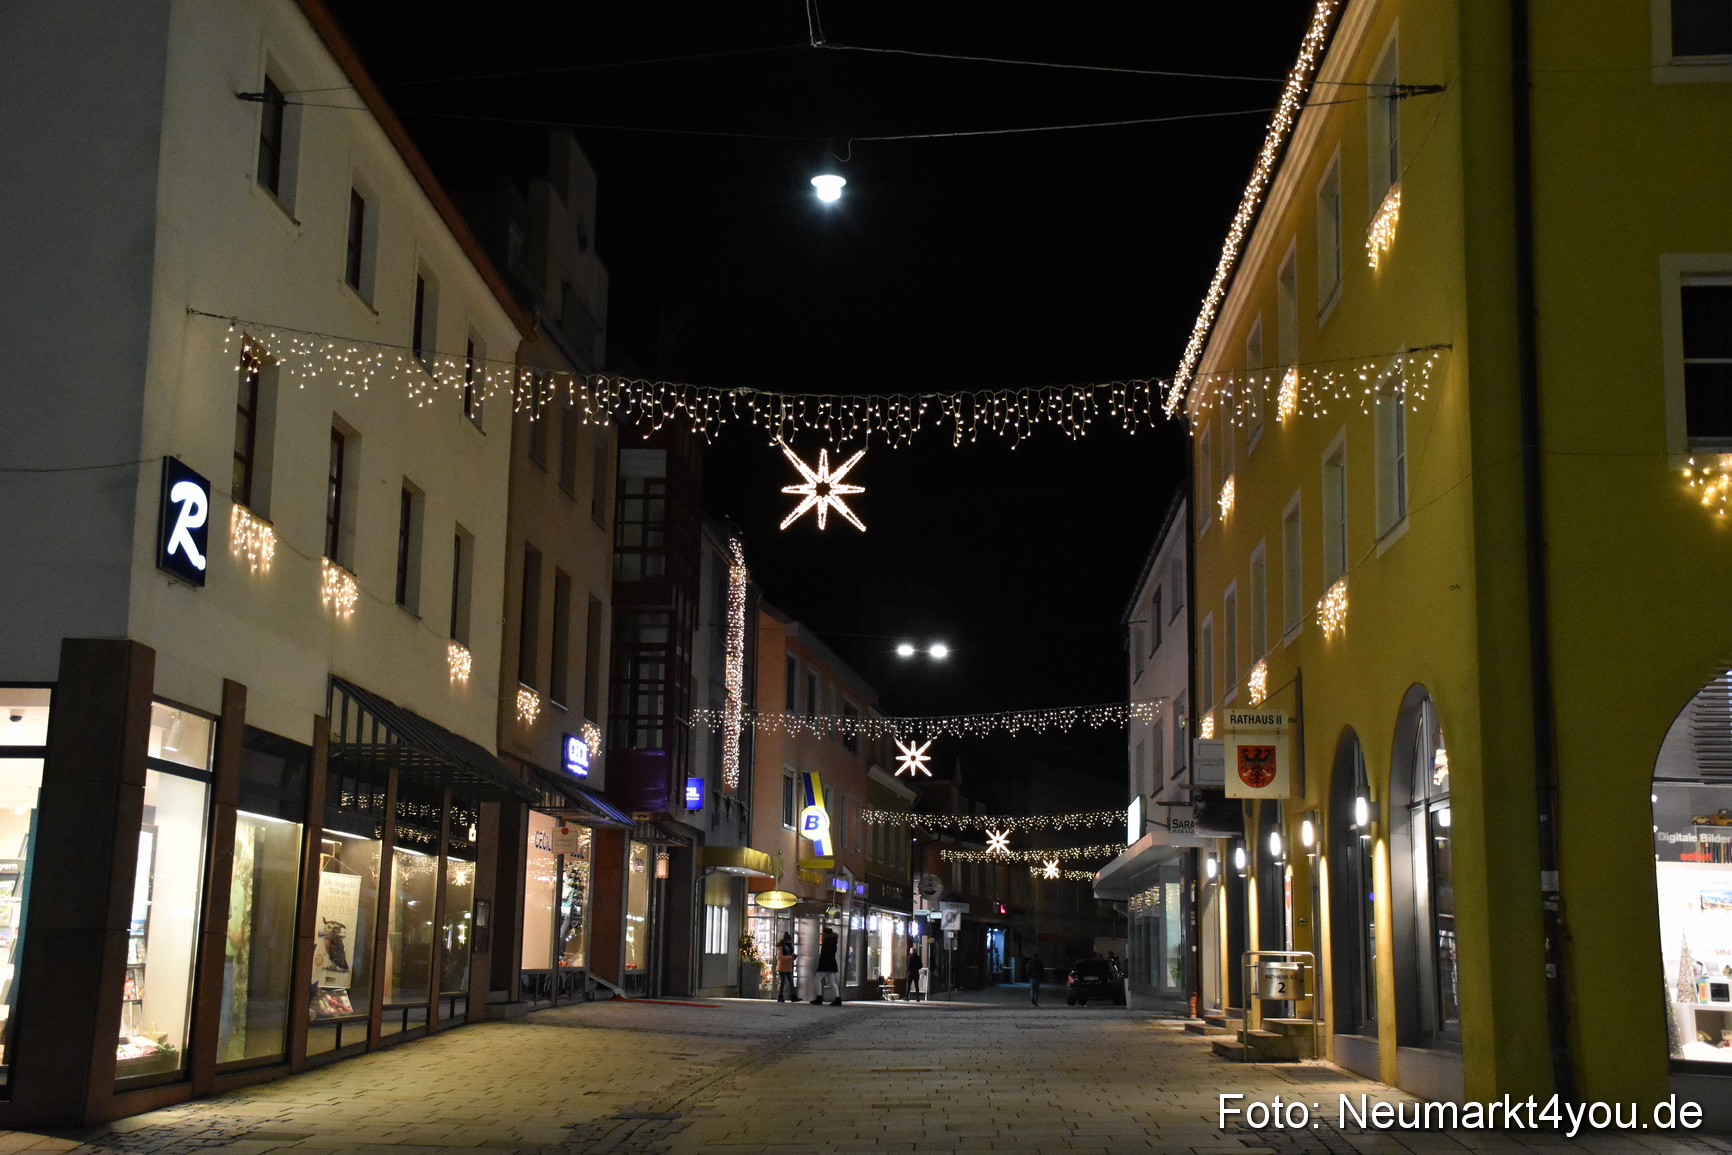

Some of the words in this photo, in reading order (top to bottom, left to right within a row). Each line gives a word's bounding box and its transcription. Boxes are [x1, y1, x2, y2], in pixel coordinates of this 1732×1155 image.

[167, 481, 208, 570] R
[1230, 714, 1274, 725] RATHAUS
[1276, 715, 1282, 725] II
[804, 815, 819, 831] B
[1657, 832, 1698, 844] Digitale
[1699, 833, 1732, 843] Bilder
[1680, 851, 1713, 861] sofort
[324, 878, 335, 886] Die
[329, 887, 341, 895] Welt
[325, 895, 351, 906] HARRY
[1278, 982, 1286, 993] 2
